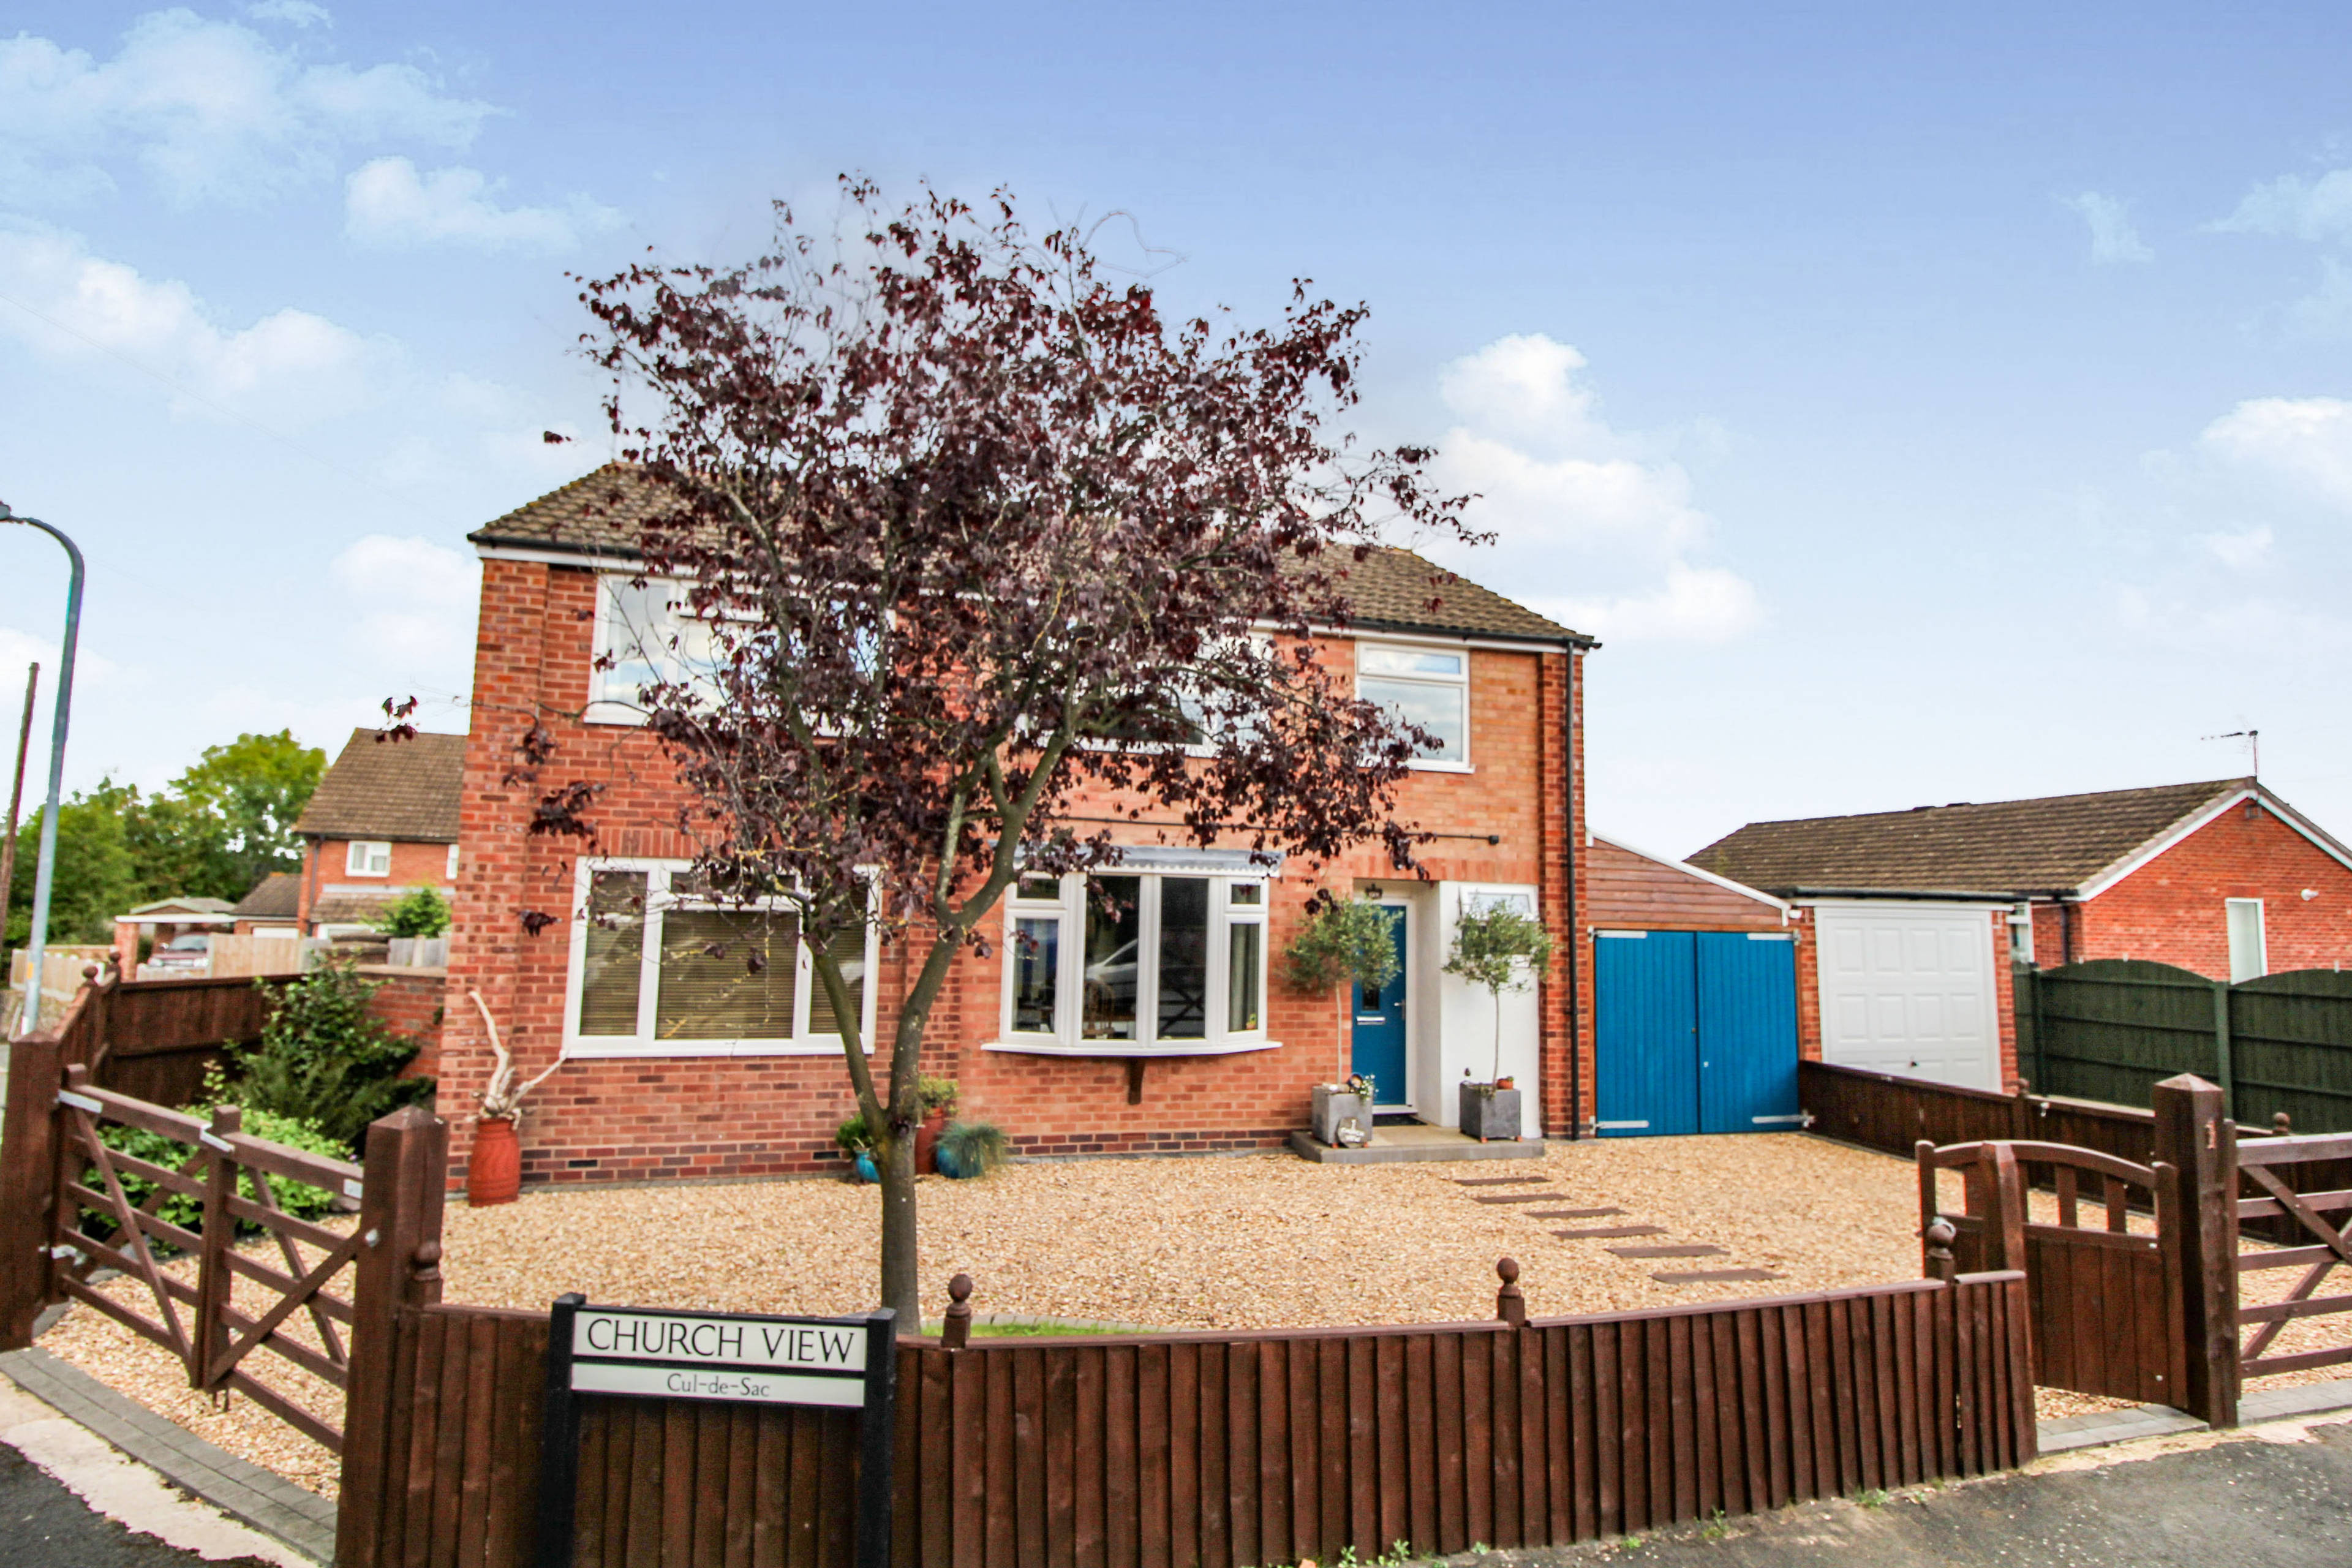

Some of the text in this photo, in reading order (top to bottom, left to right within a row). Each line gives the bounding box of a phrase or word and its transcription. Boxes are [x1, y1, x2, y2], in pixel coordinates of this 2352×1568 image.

[587, 1317, 856, 1364] CHURCH VIEW
[666, 1373, 771, 1397] Cul-de-Sac
